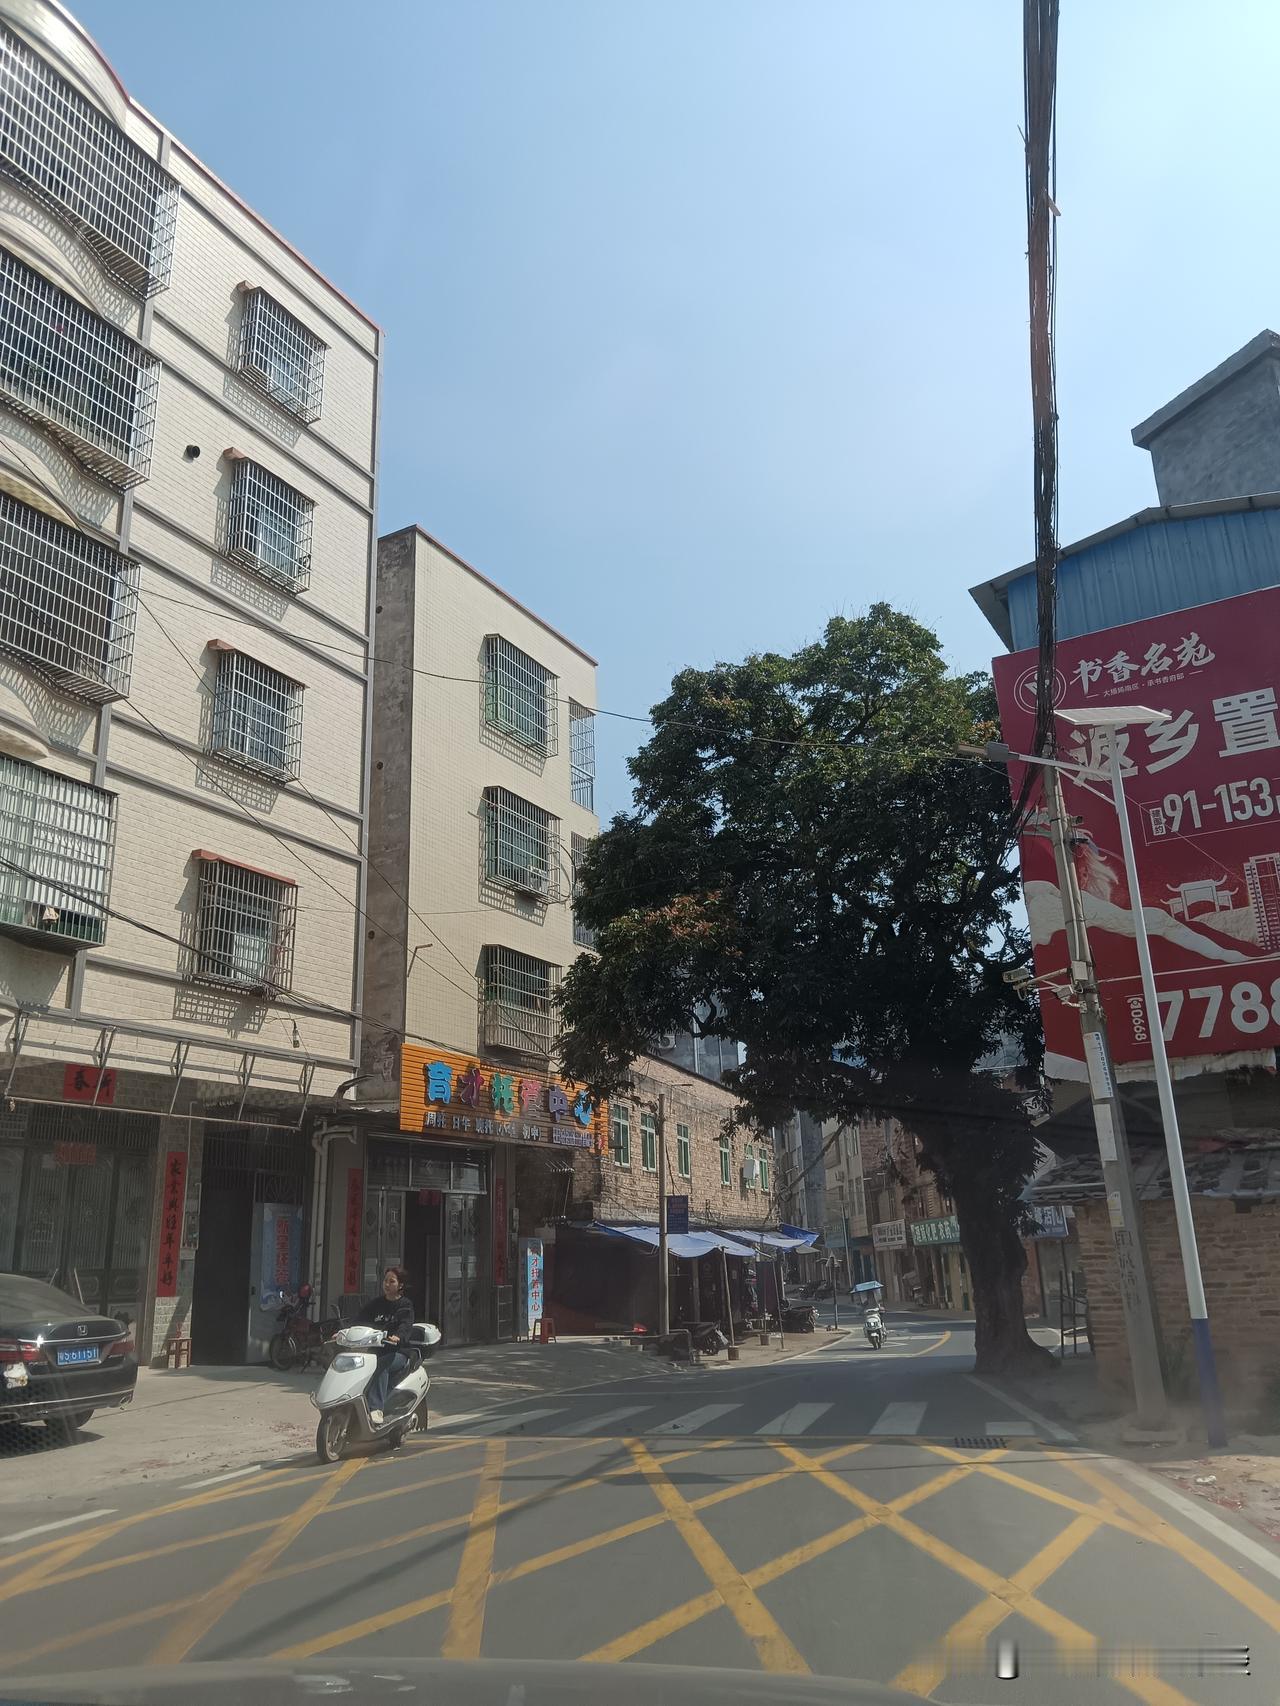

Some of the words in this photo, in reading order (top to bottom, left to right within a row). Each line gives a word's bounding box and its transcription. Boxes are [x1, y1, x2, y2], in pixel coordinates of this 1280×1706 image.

[1070, 632, 1216, 696] 书香名苑
[1163, 776, 1280, 833] 91-153
[1157, 977, 1280, 1042] 778
